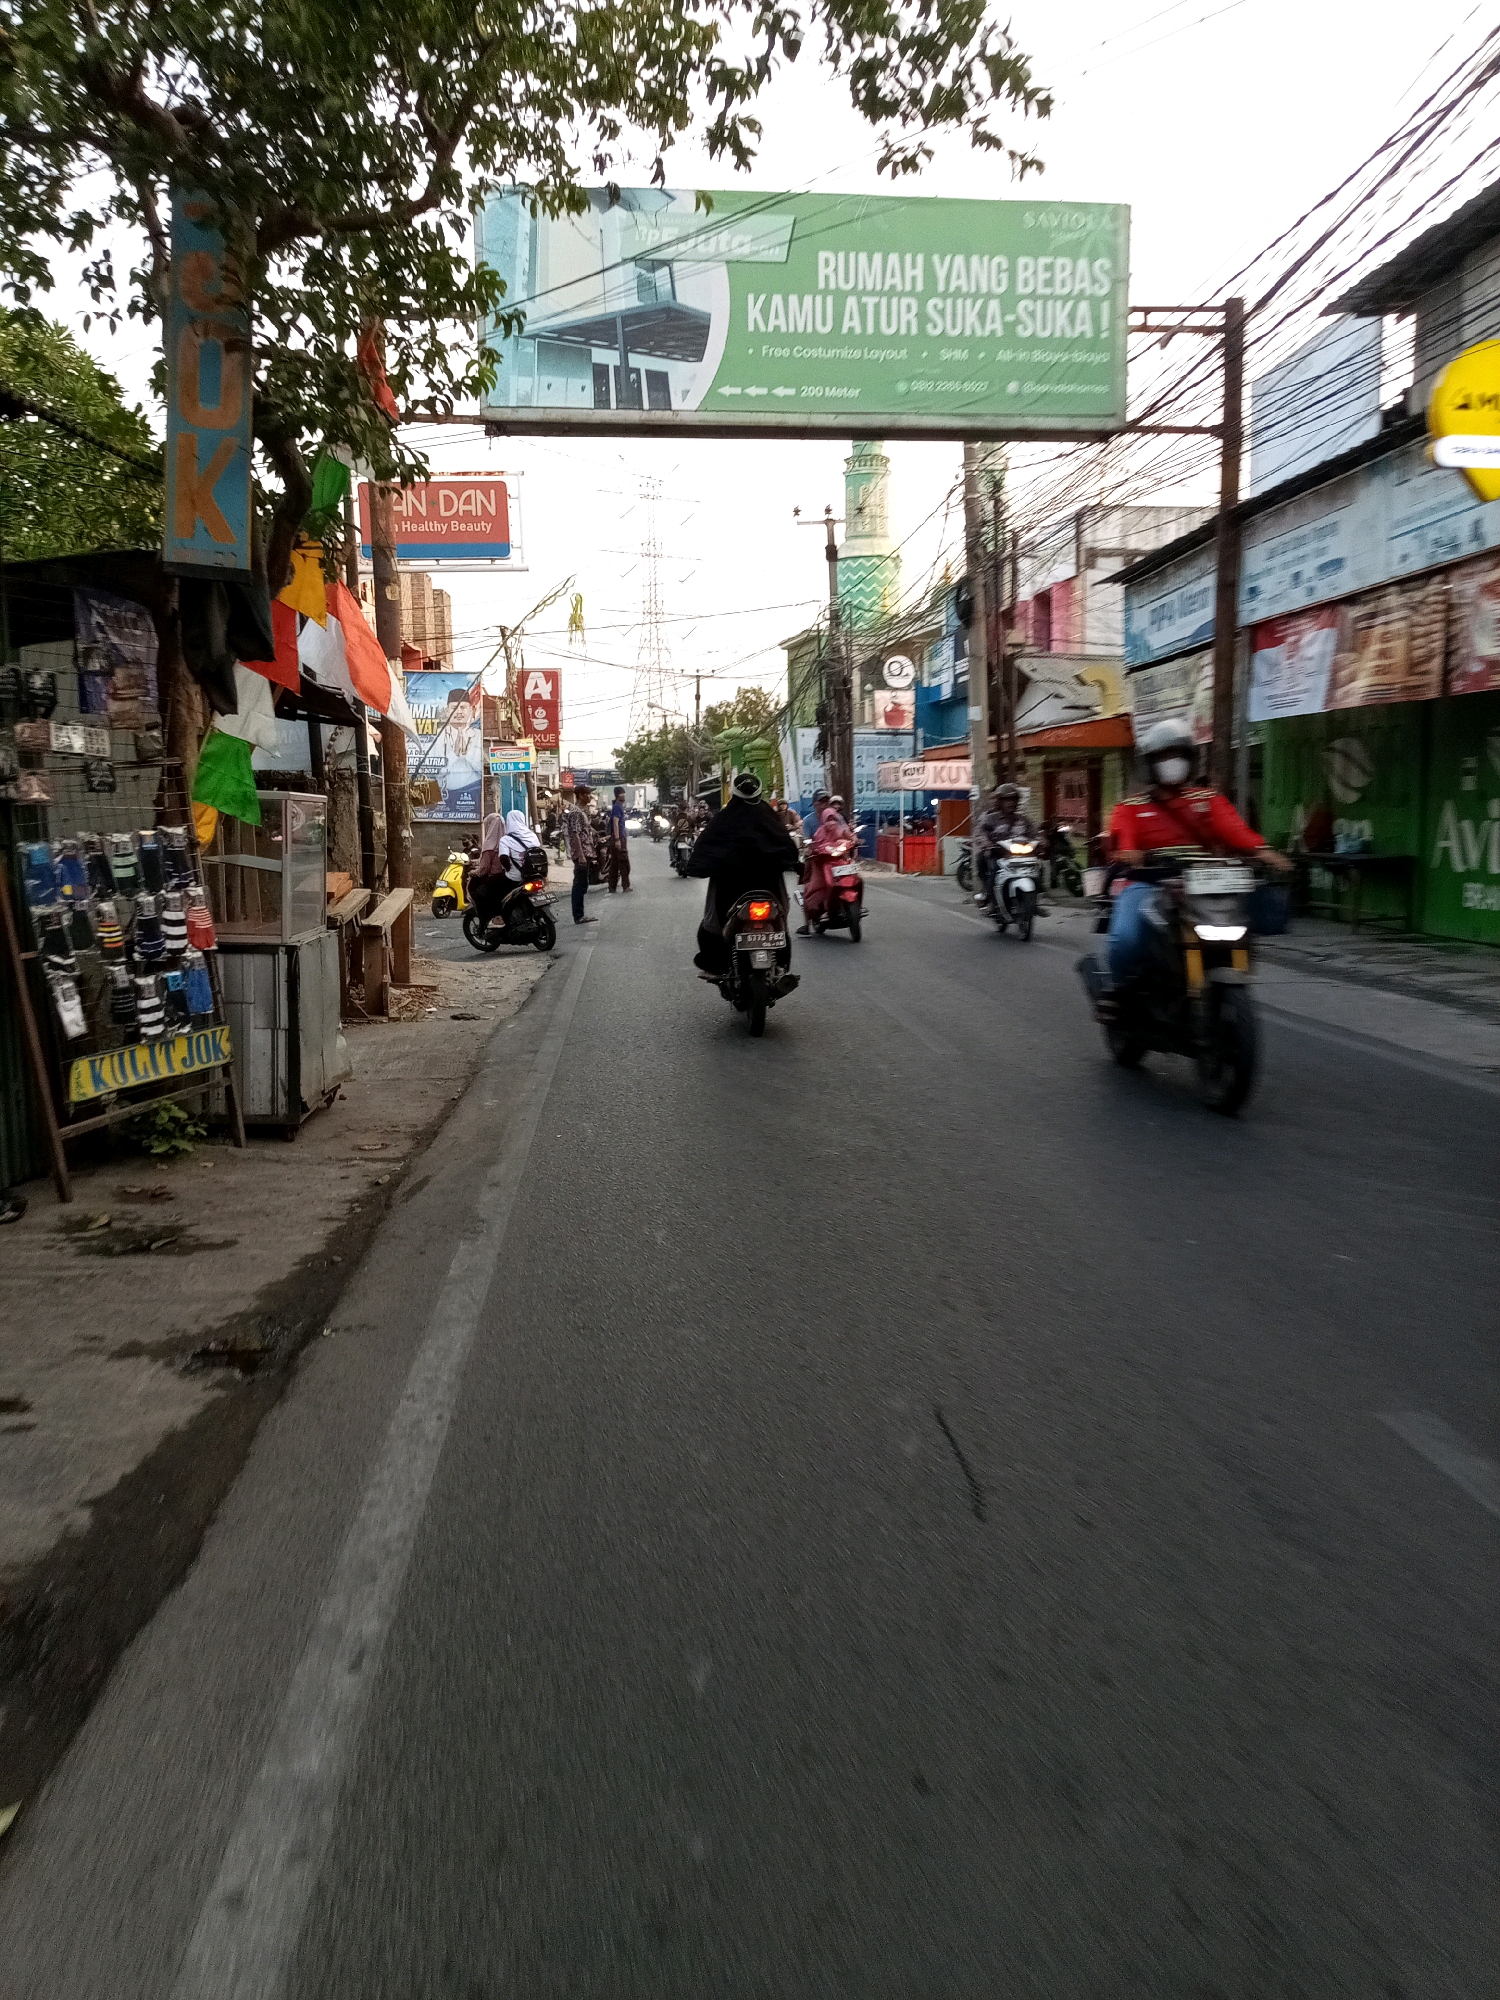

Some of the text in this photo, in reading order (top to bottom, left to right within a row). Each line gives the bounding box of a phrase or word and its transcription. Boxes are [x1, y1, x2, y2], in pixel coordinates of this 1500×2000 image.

[817, 250, 1113, 297] RUMAH YANG BEBAS
[747, 292, 834, 335] KAMU
[841, 294, 919, 336] ATUR
[761, 345, 909, 363] Free Costumize Layout
[800, 385, 862, 398] 200 Meter
[439, 488, 496, 517] DAN
[401, 520, 449, 535] Healthy
[450, 520, 493, 534] Beauty
[492, 762, 515, 771] 100 M
[87, 1039, 177, 1093] KULIT
[181, 1028, 230, 1070] JOK
